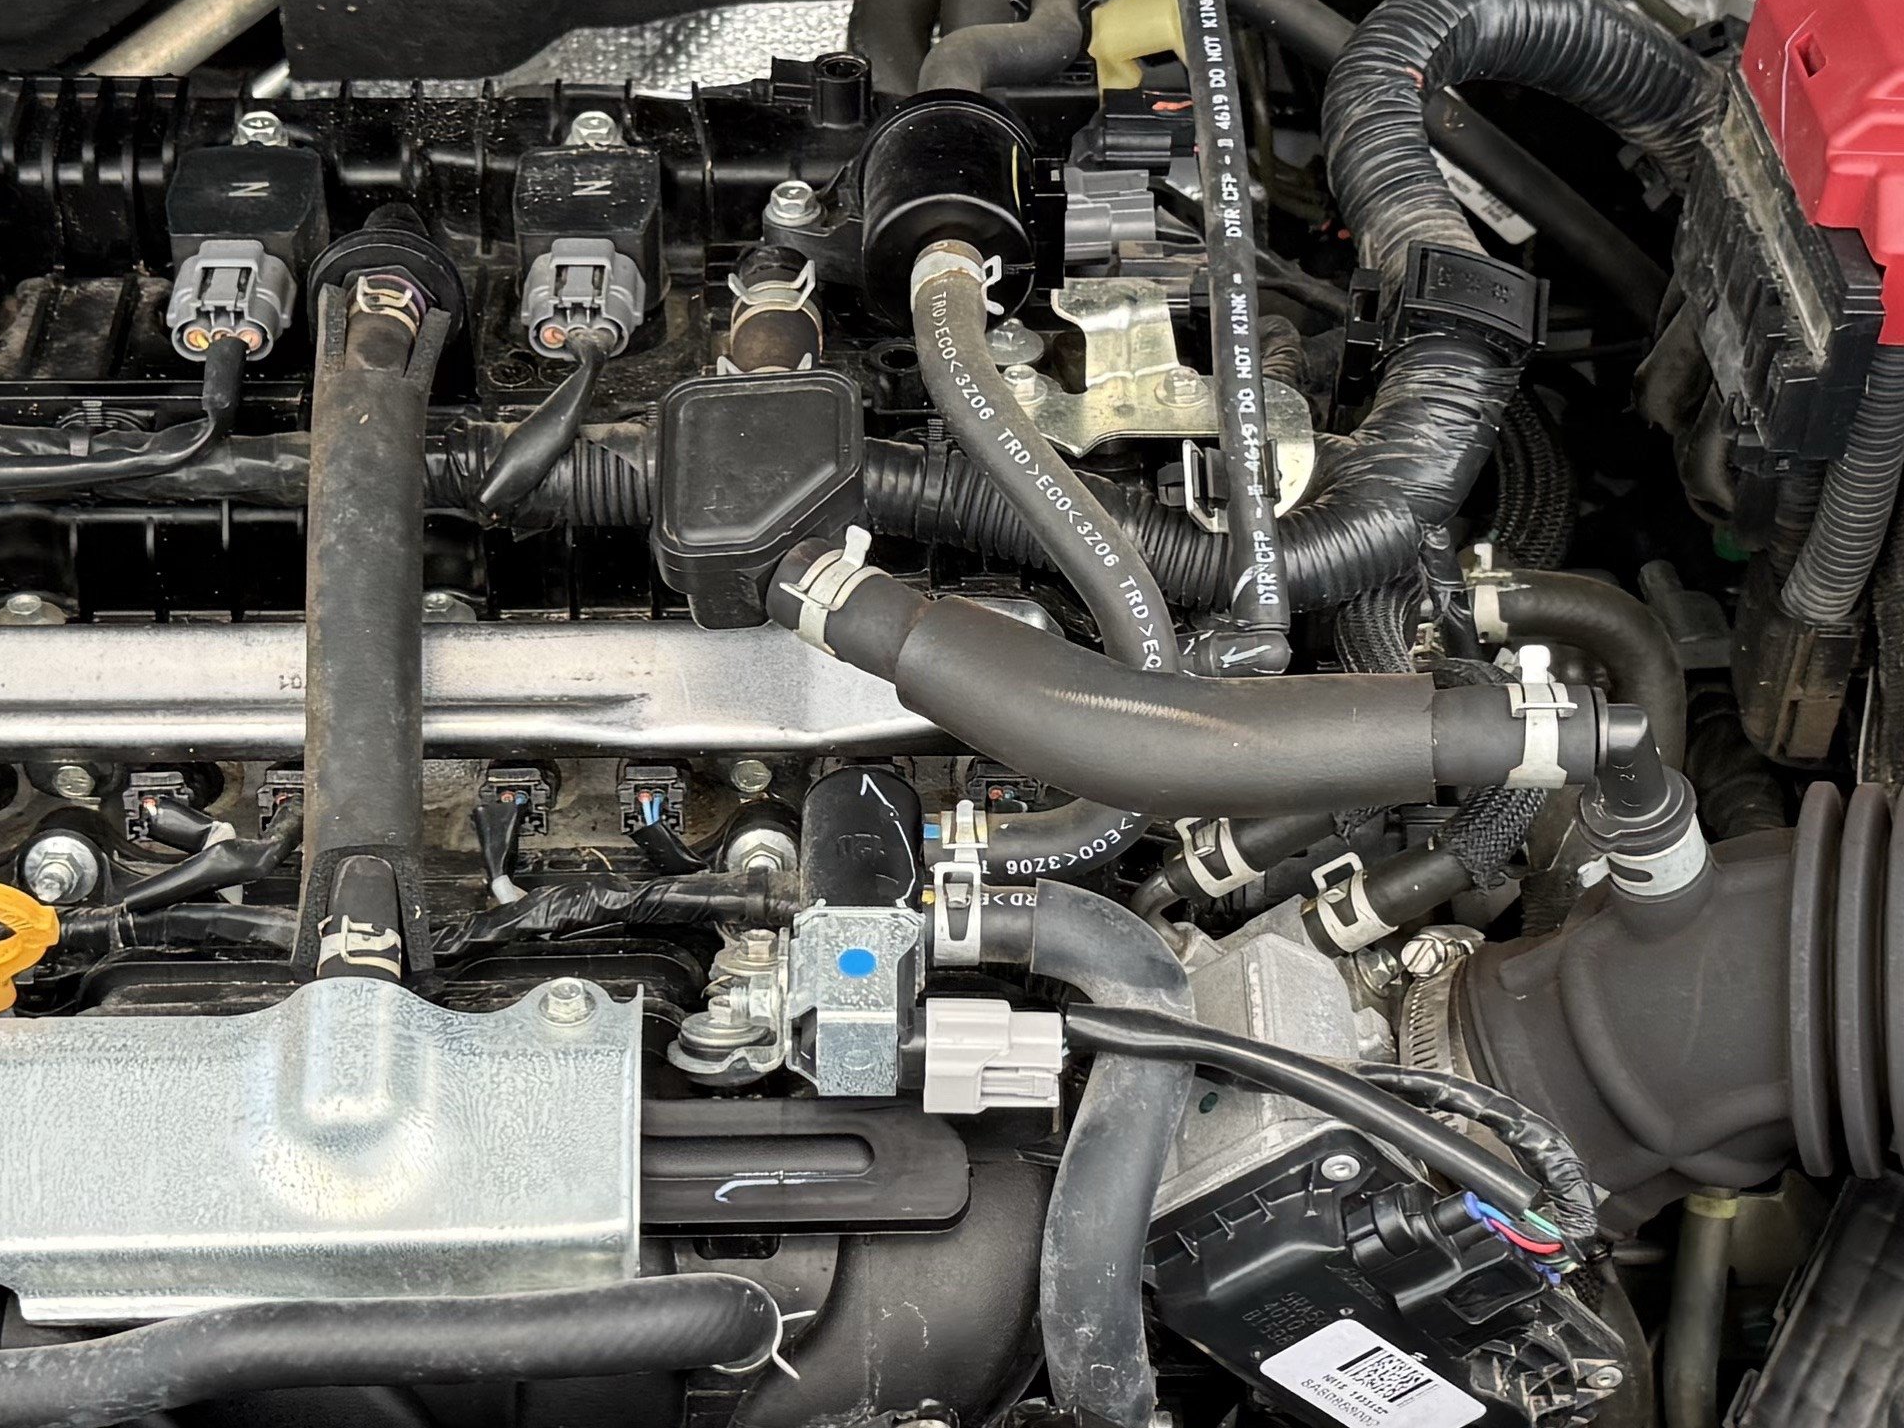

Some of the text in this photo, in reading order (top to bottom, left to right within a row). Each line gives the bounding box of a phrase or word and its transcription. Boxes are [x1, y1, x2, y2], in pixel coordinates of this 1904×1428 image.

[1204, 36, 1222, 61] NOT
[1208, 69, 1226, 87] DO
[1212, 94, 1231, 130] 4619
[1230, 293, 1248, 335] KINK
[1233, 344, 1251, 378] NOT
